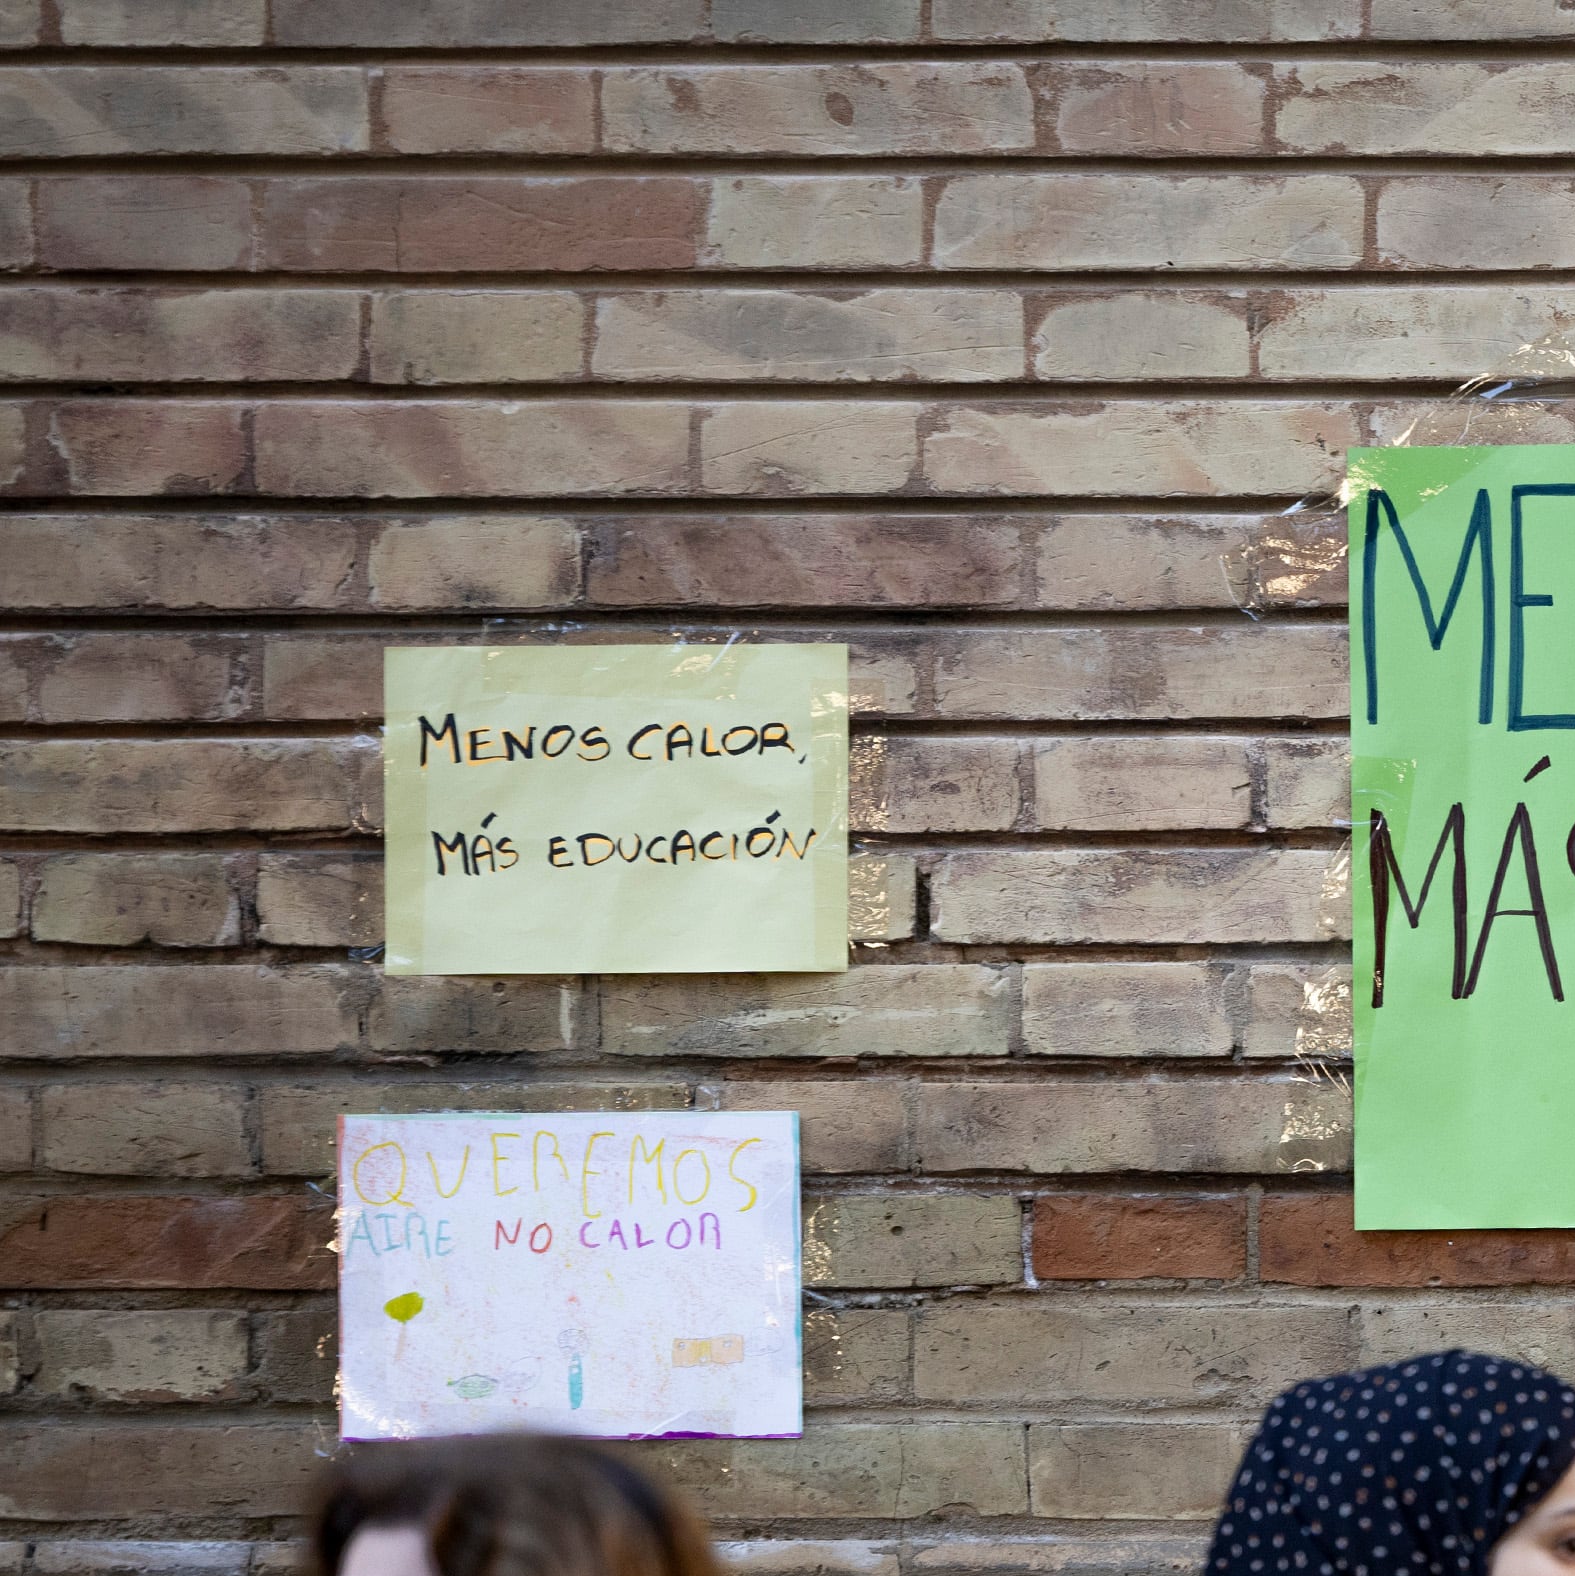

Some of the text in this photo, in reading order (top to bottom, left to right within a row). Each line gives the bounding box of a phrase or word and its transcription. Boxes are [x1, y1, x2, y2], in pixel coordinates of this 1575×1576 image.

[418, 713, 808, 768] MENOS CALOR,
[432, 810, 816, 876] MÁS EDUCACIÓN
[352, 1131, 765, 1220] QUEREMOS
[344, 1210, 722, 1259] AIRE NO CALOR
